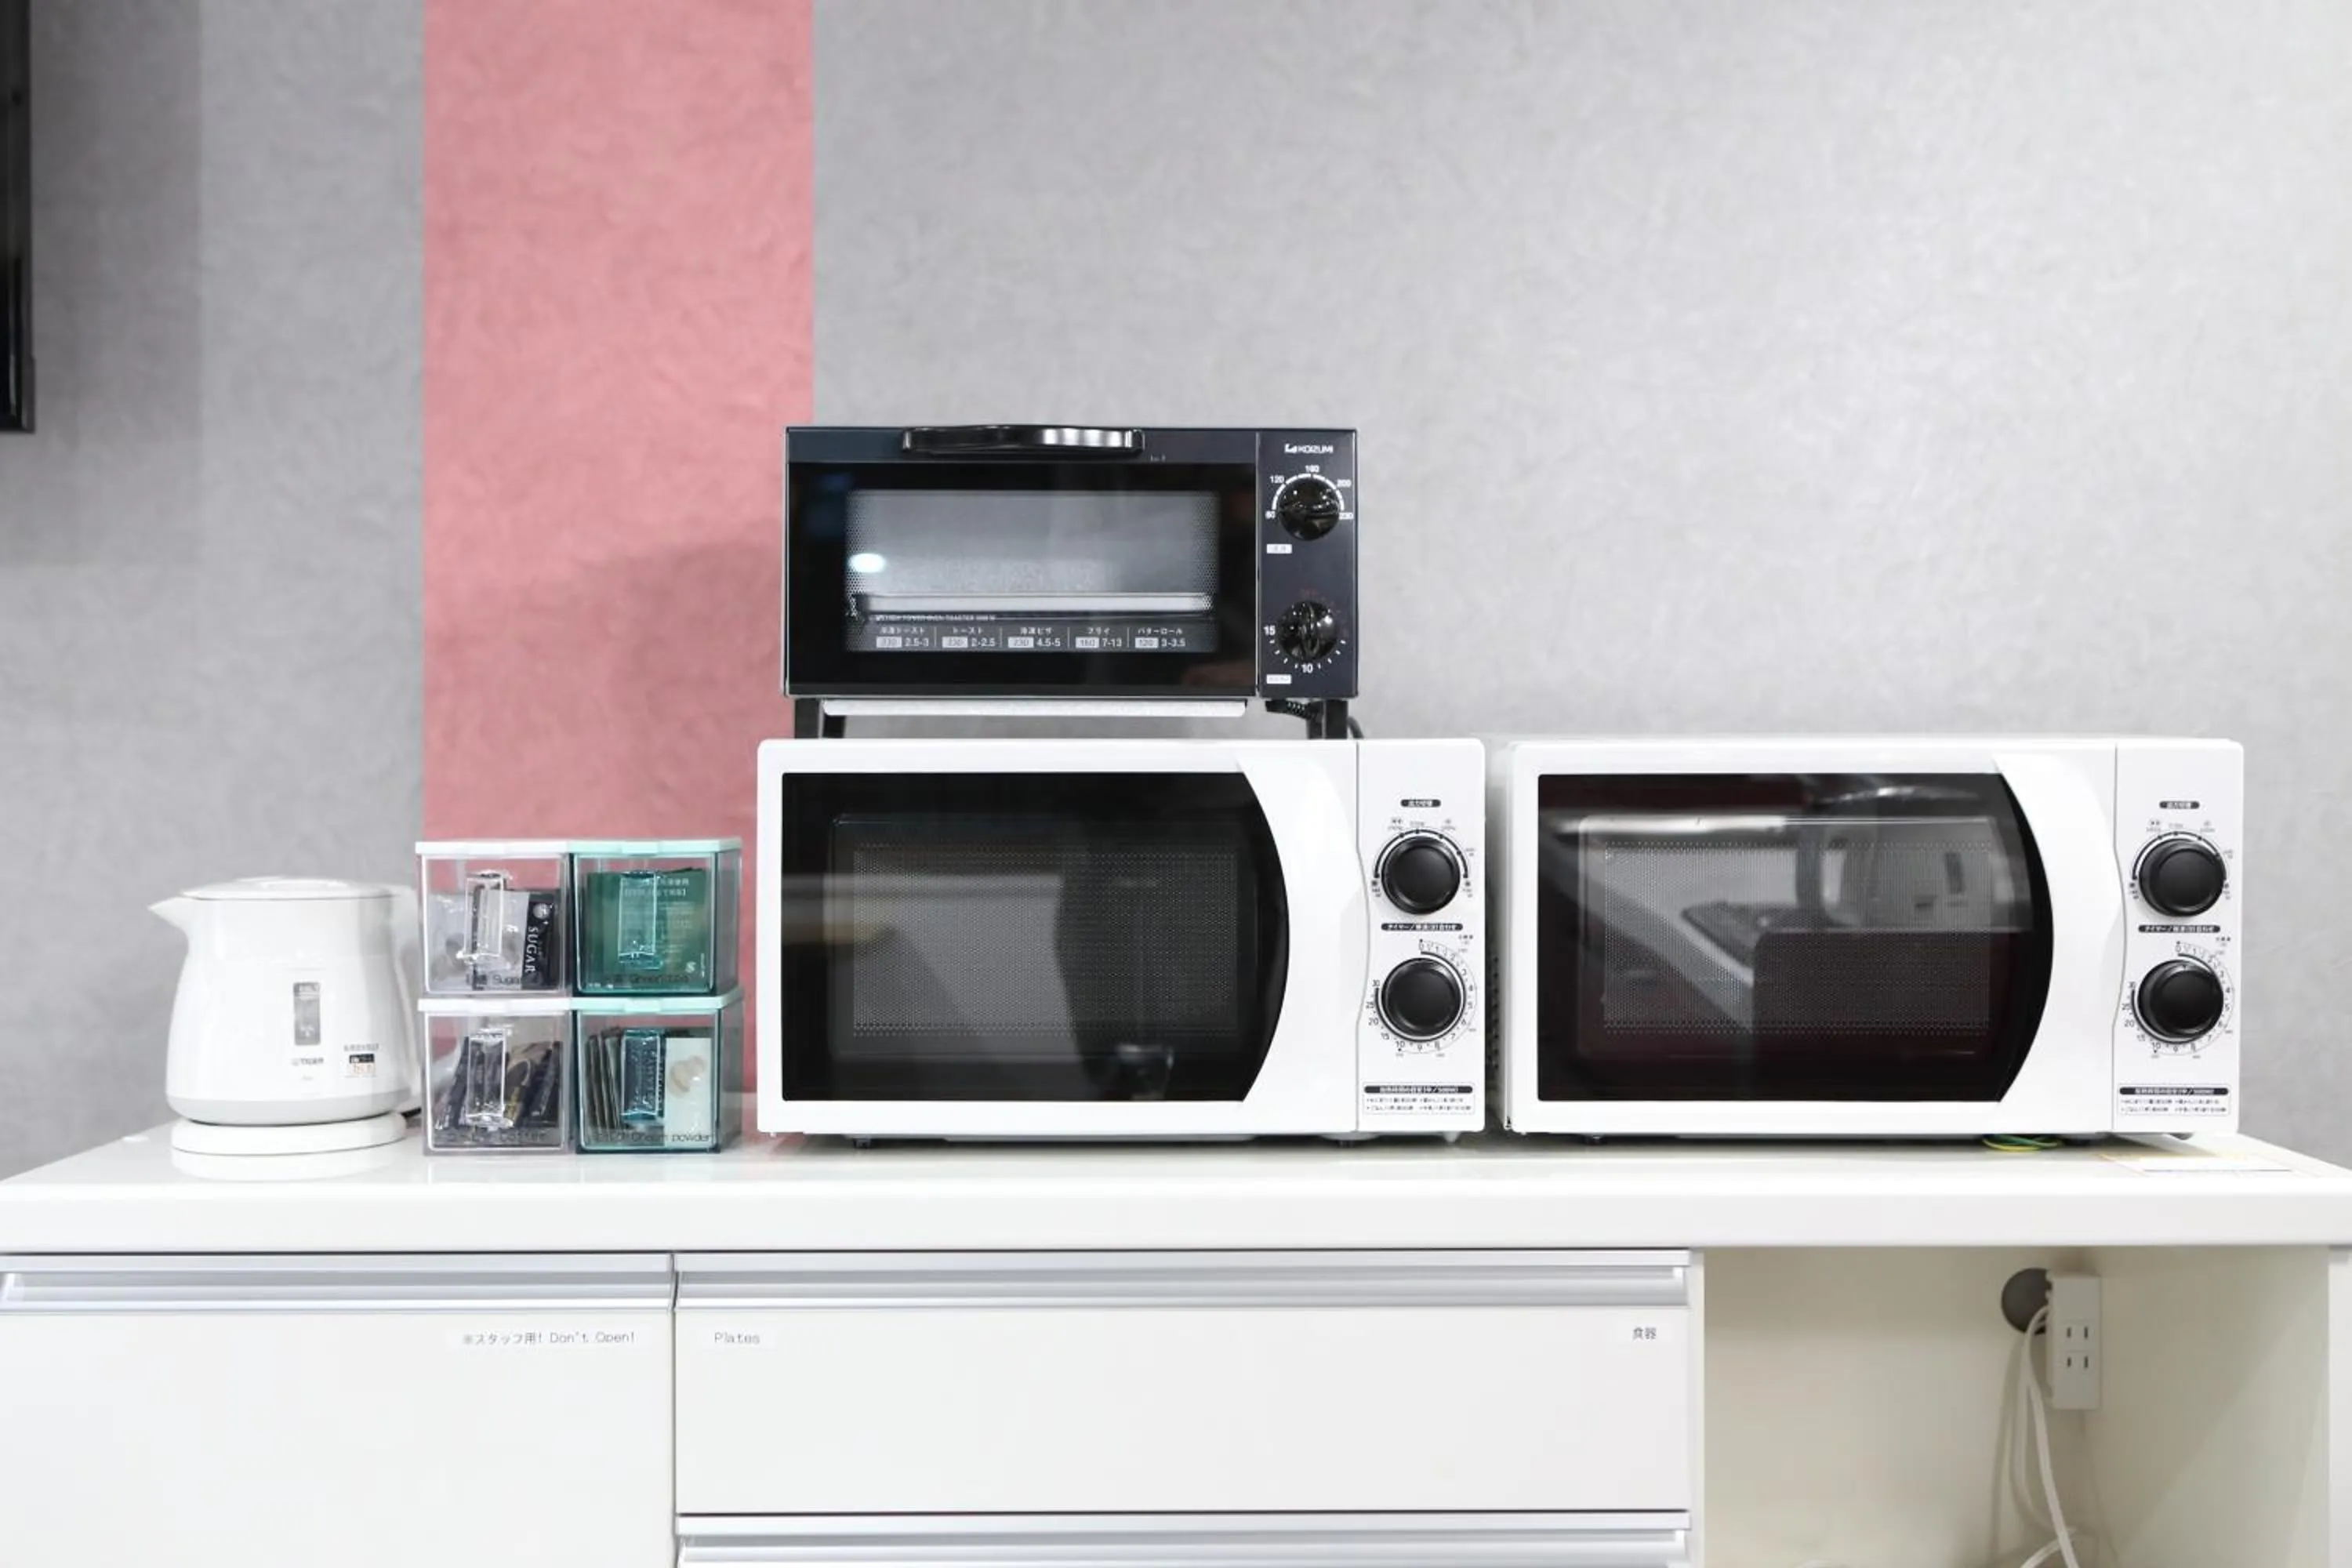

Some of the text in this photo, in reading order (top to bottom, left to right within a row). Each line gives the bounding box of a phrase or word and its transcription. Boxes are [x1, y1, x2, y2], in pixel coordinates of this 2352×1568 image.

[1264, 625, 1276, 636] 15
[1301, 663, 1313, 673] 10
[524, 925, 539, 973] SUGAR
[1396, 1040, 1406, 1049] 10
[671, 1132, 710, 1142] powder
[550, 1331, 589, 1344] Don't
[594, 1330, 634, 1344] Open!
